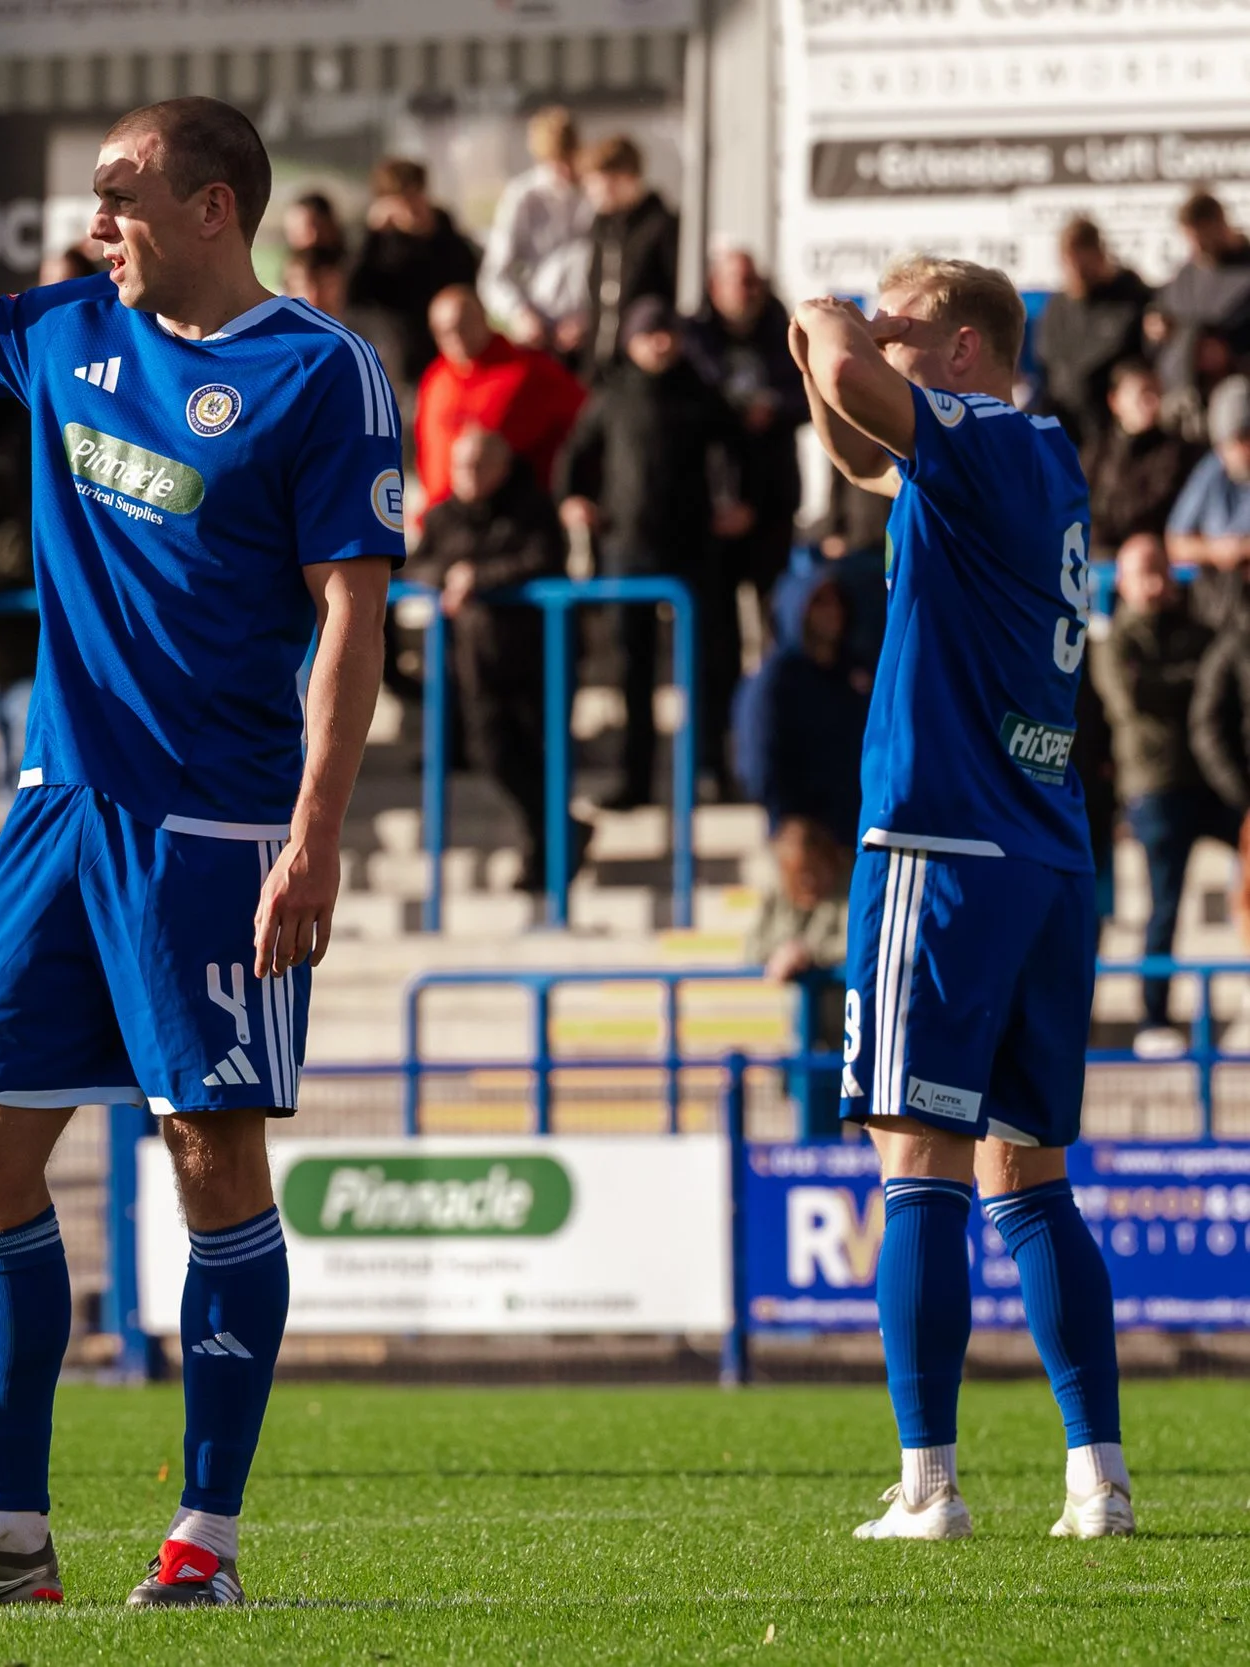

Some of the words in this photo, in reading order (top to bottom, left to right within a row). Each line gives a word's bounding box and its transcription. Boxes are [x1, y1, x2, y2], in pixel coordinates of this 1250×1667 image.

[70, 438, 175, 498] Pinnacle
[115, 495, 164, 525] Supplies
[1053, 521, 1090, 674] 9
[320, 1164, 534, 1230] Pinnacle
